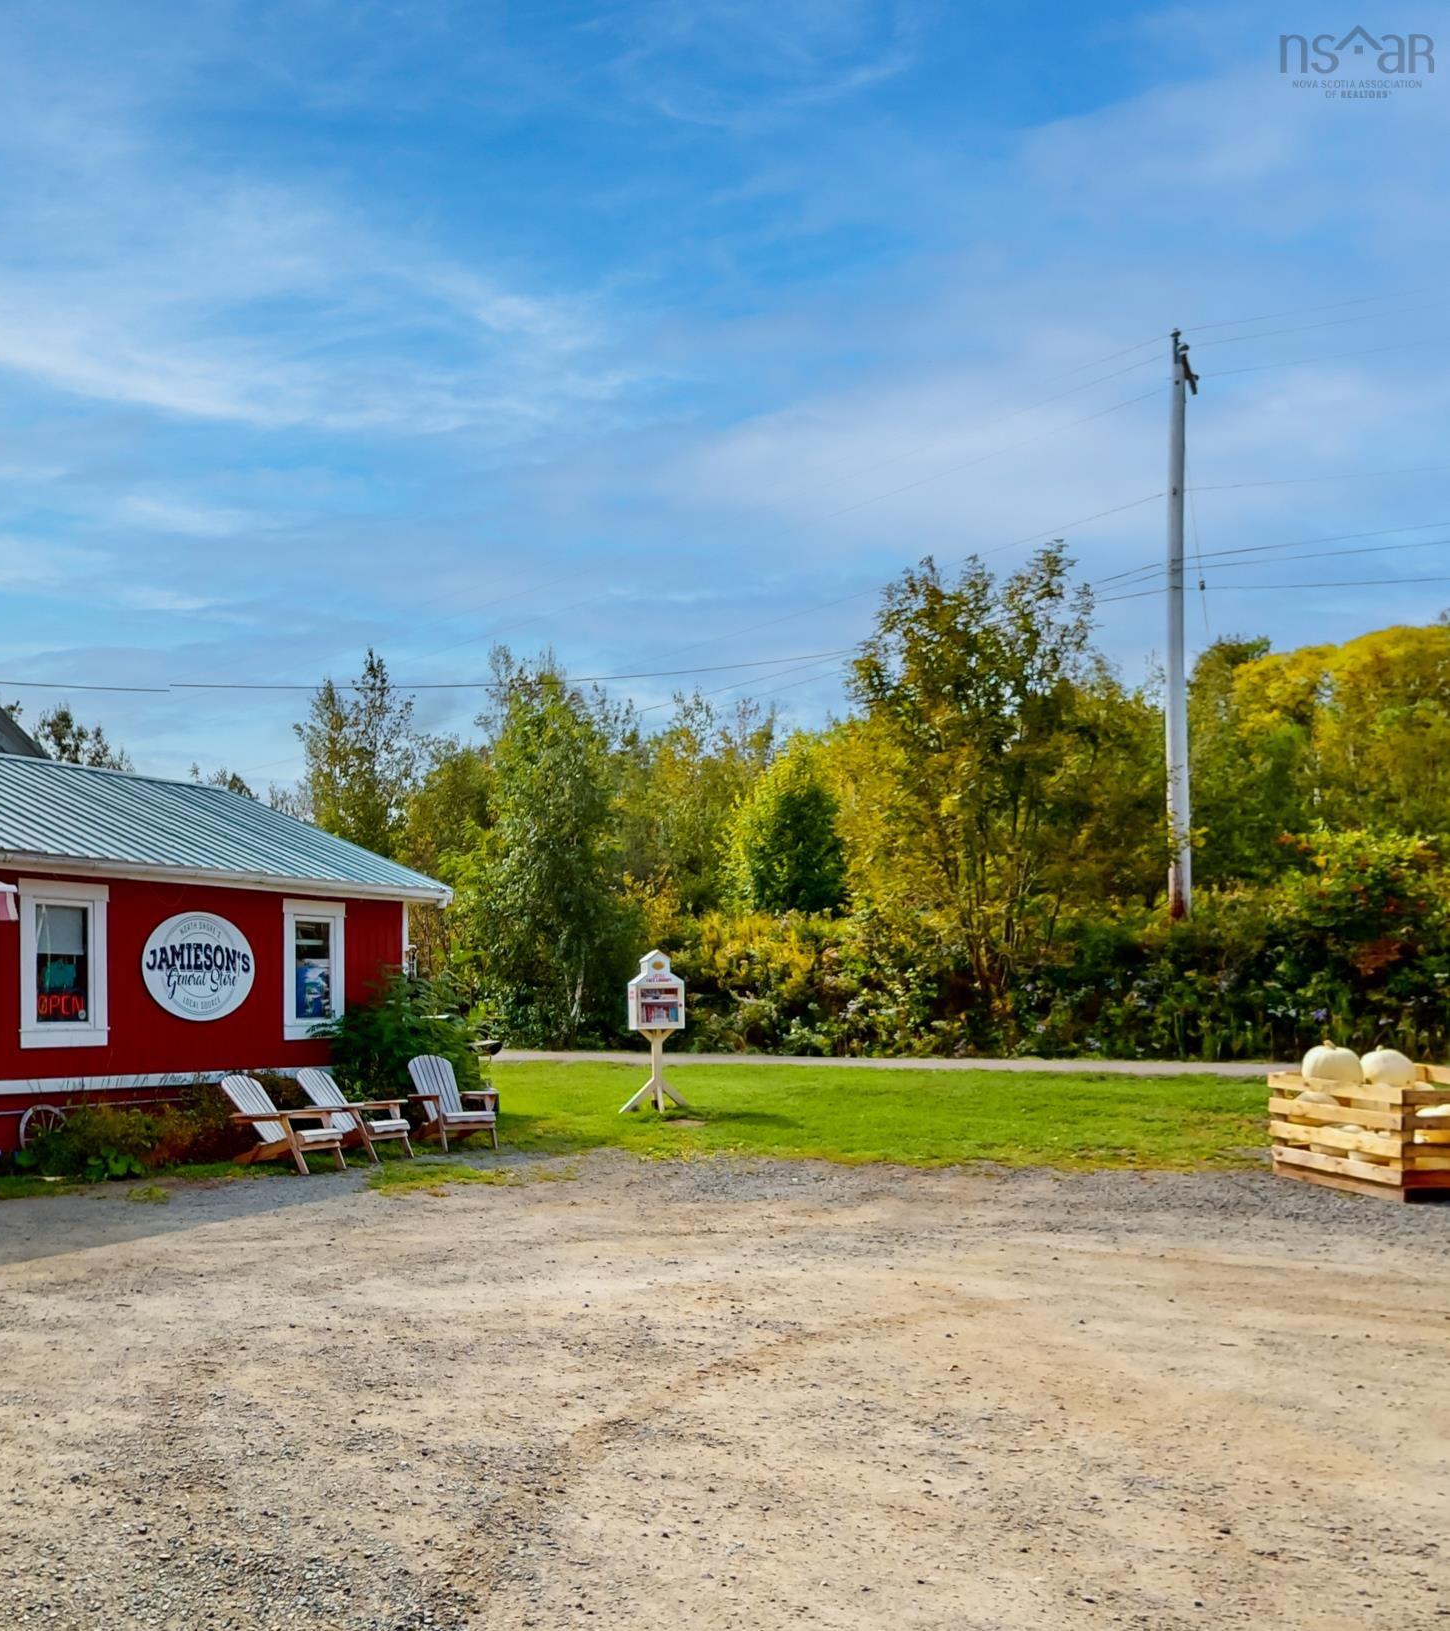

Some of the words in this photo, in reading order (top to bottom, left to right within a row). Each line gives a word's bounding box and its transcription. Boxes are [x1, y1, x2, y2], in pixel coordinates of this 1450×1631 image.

[146, 942, 251, 974] JAMIESON'S
[166, 967, 206, 1000] General
[210, 968, 237, 992] Store
[37, 994, 84, 1016] OPEN
[182, 996, 200, 1009] LOCAL
